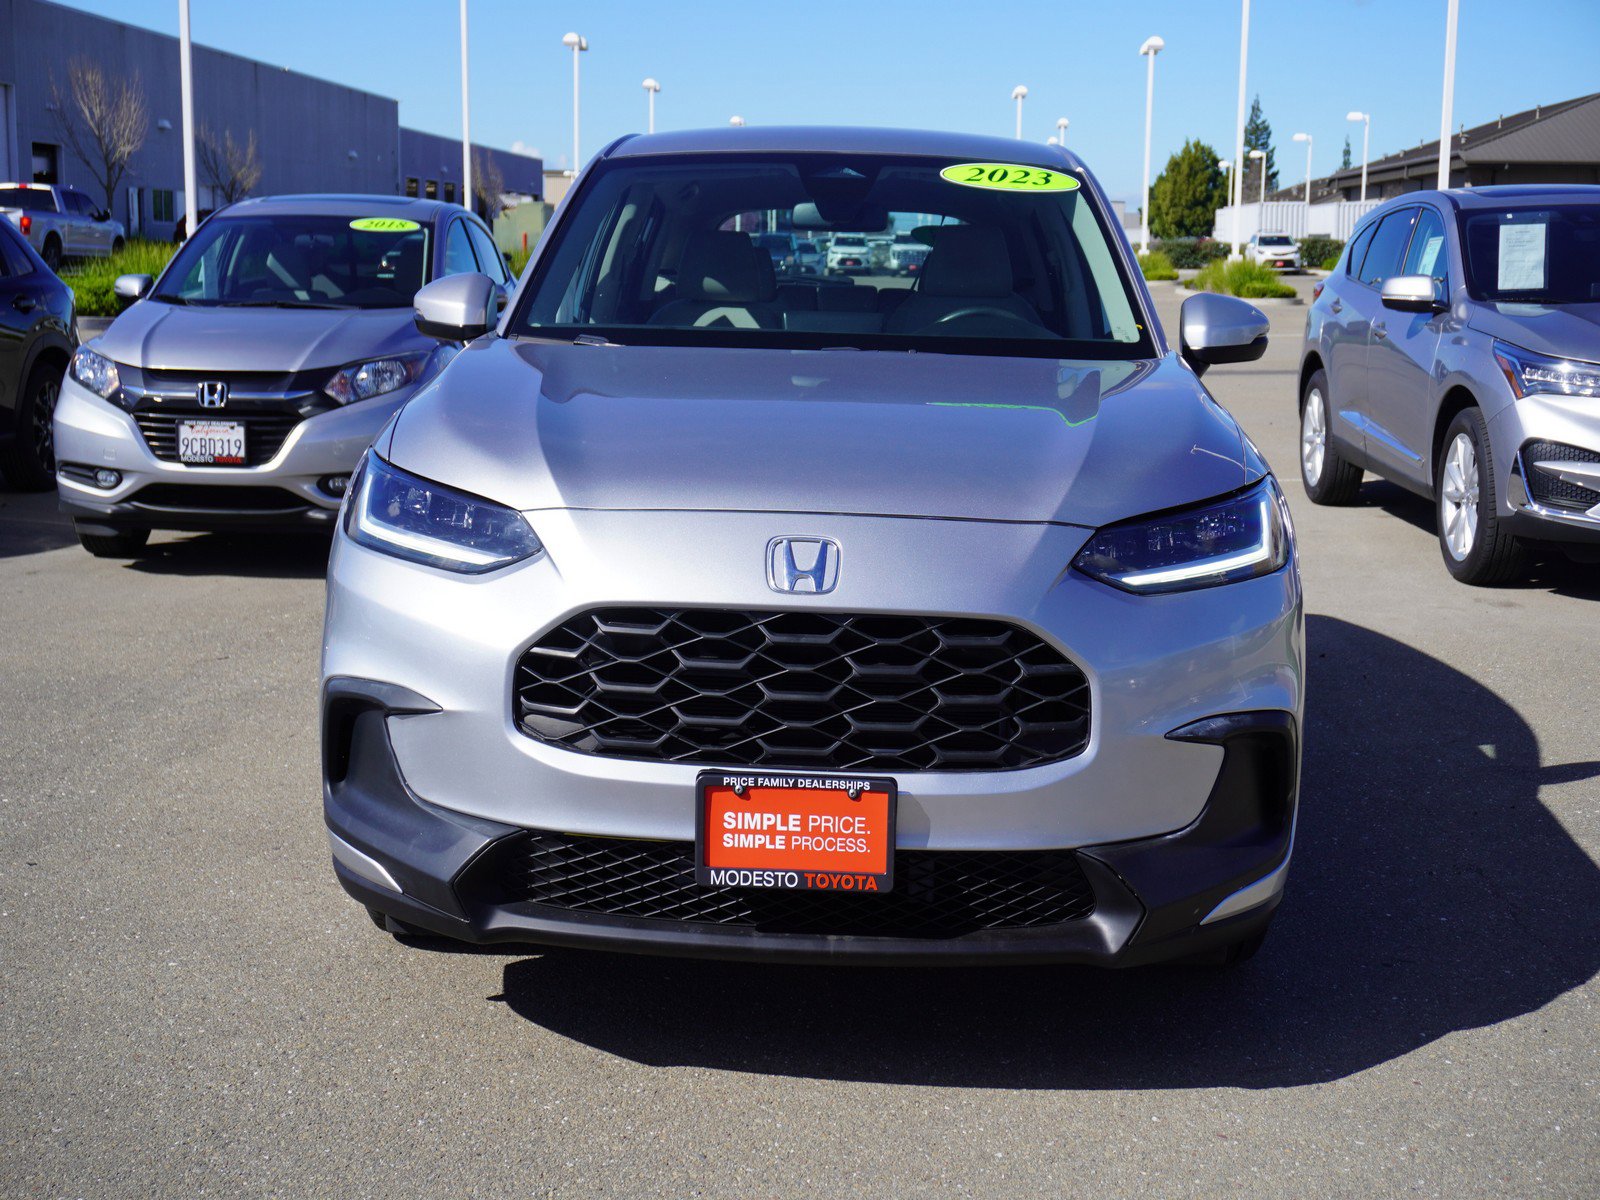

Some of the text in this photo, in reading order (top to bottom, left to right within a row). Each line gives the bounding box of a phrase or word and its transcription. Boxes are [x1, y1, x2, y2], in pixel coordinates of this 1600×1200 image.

[963, 167, 1052, 185] 2023
[182, 437, 242, 458] 9CBD319
[181, 454, 243, 464] MODESTO TOYOTA
[723, 777, 871, 790] PRICE FAMILY DEALERSHIPS
[723, 811, 871, 835] SIMPLE PRICE.
[722, 833, 871, 853] SIMPLE PROCESS.
[710, 869, 878, 891] MODESTO TOYOTA
